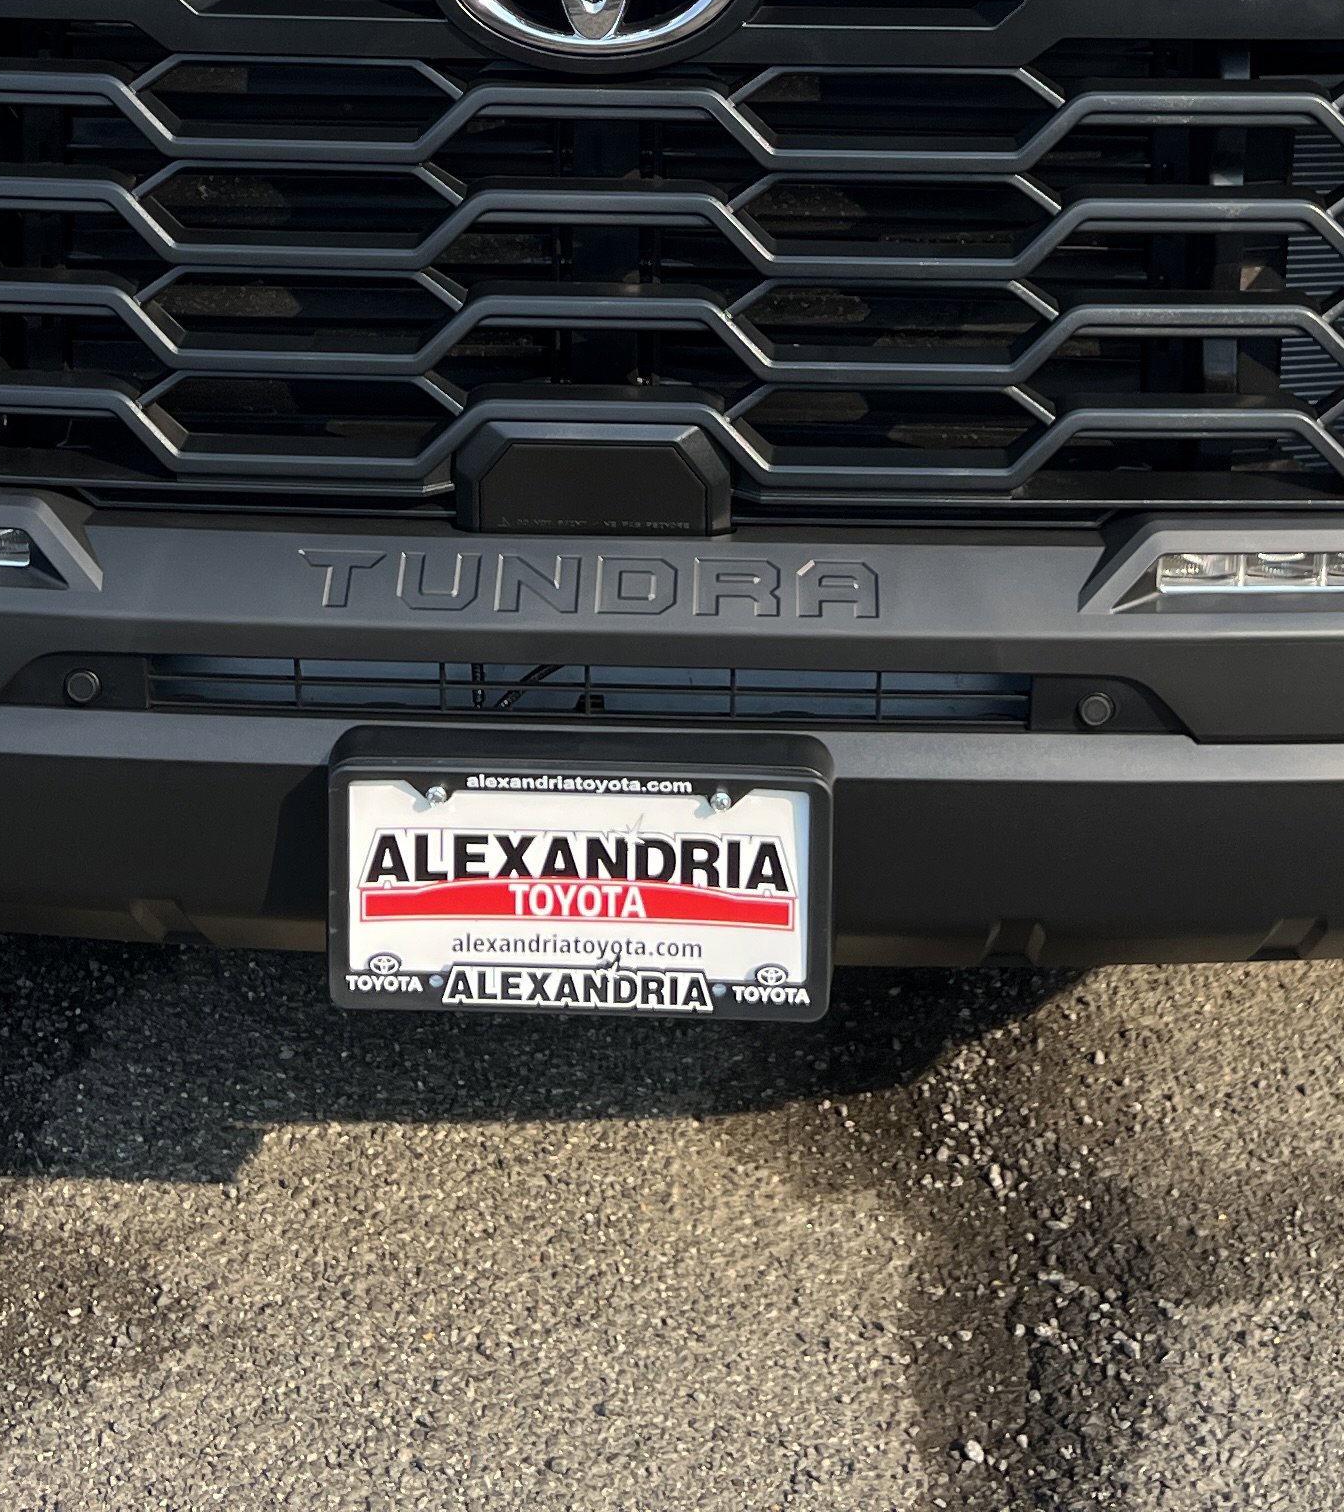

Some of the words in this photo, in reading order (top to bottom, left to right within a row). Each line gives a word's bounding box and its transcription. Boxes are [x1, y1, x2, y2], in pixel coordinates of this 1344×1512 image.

[297, 548, 881, 619] TUNDRA
[466, 773, 693, 794] alexandriatoyota.com
[365, 832, 789, 892] ALEXANDRIA
[508, 883, 647, 919] TOYOTA
[452, 932, 703, 960] alexandriatoyota.com
[346, 975, 424, 994] TOYOTA
[445, 968, 709, 1009] ALEXANDRIA
[732, 985, 811, 1006] TOYOTA
